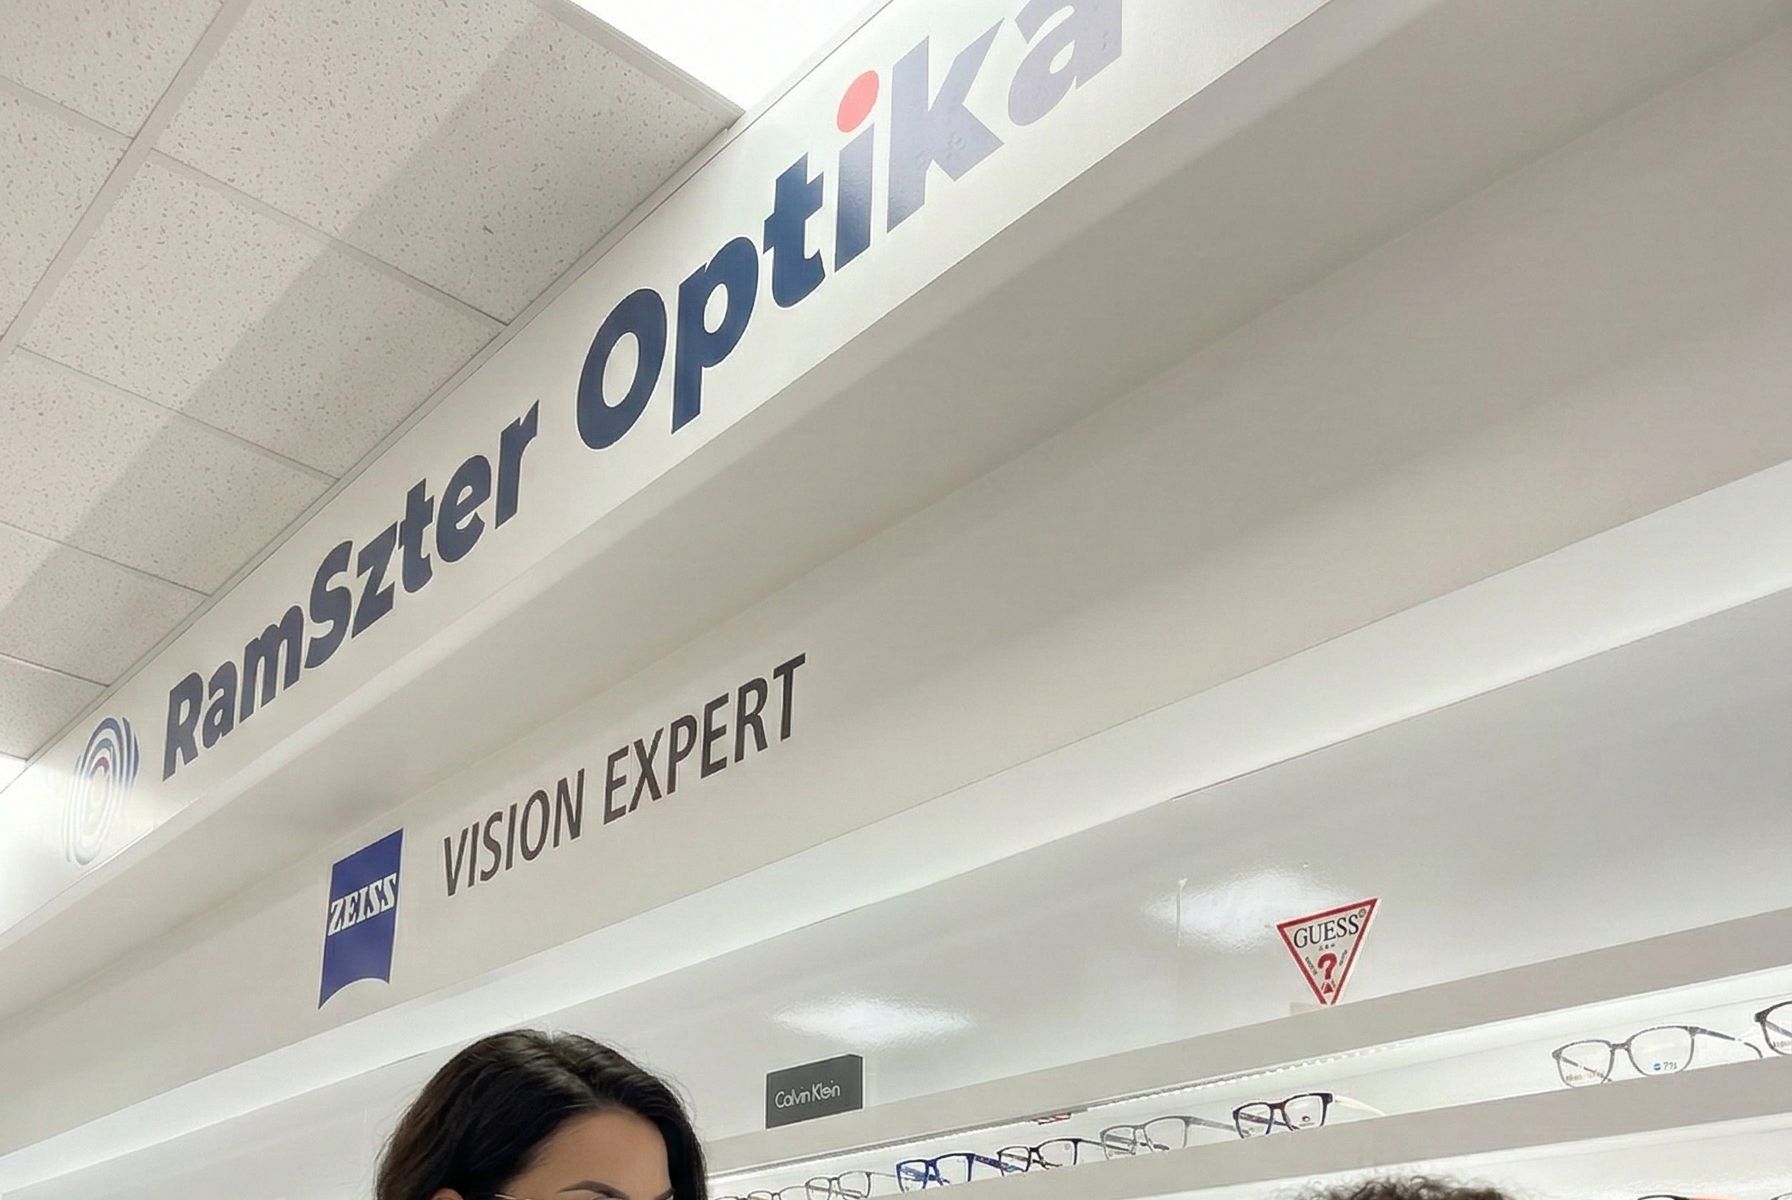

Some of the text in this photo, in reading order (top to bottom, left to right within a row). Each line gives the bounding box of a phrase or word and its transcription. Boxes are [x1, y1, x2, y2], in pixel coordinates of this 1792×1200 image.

[163, 0, 1123, 780] RamSzter Optika
[443, 653, 806, 896] VISION EXPERT
[327, 872, 397, 936] ZEISS
